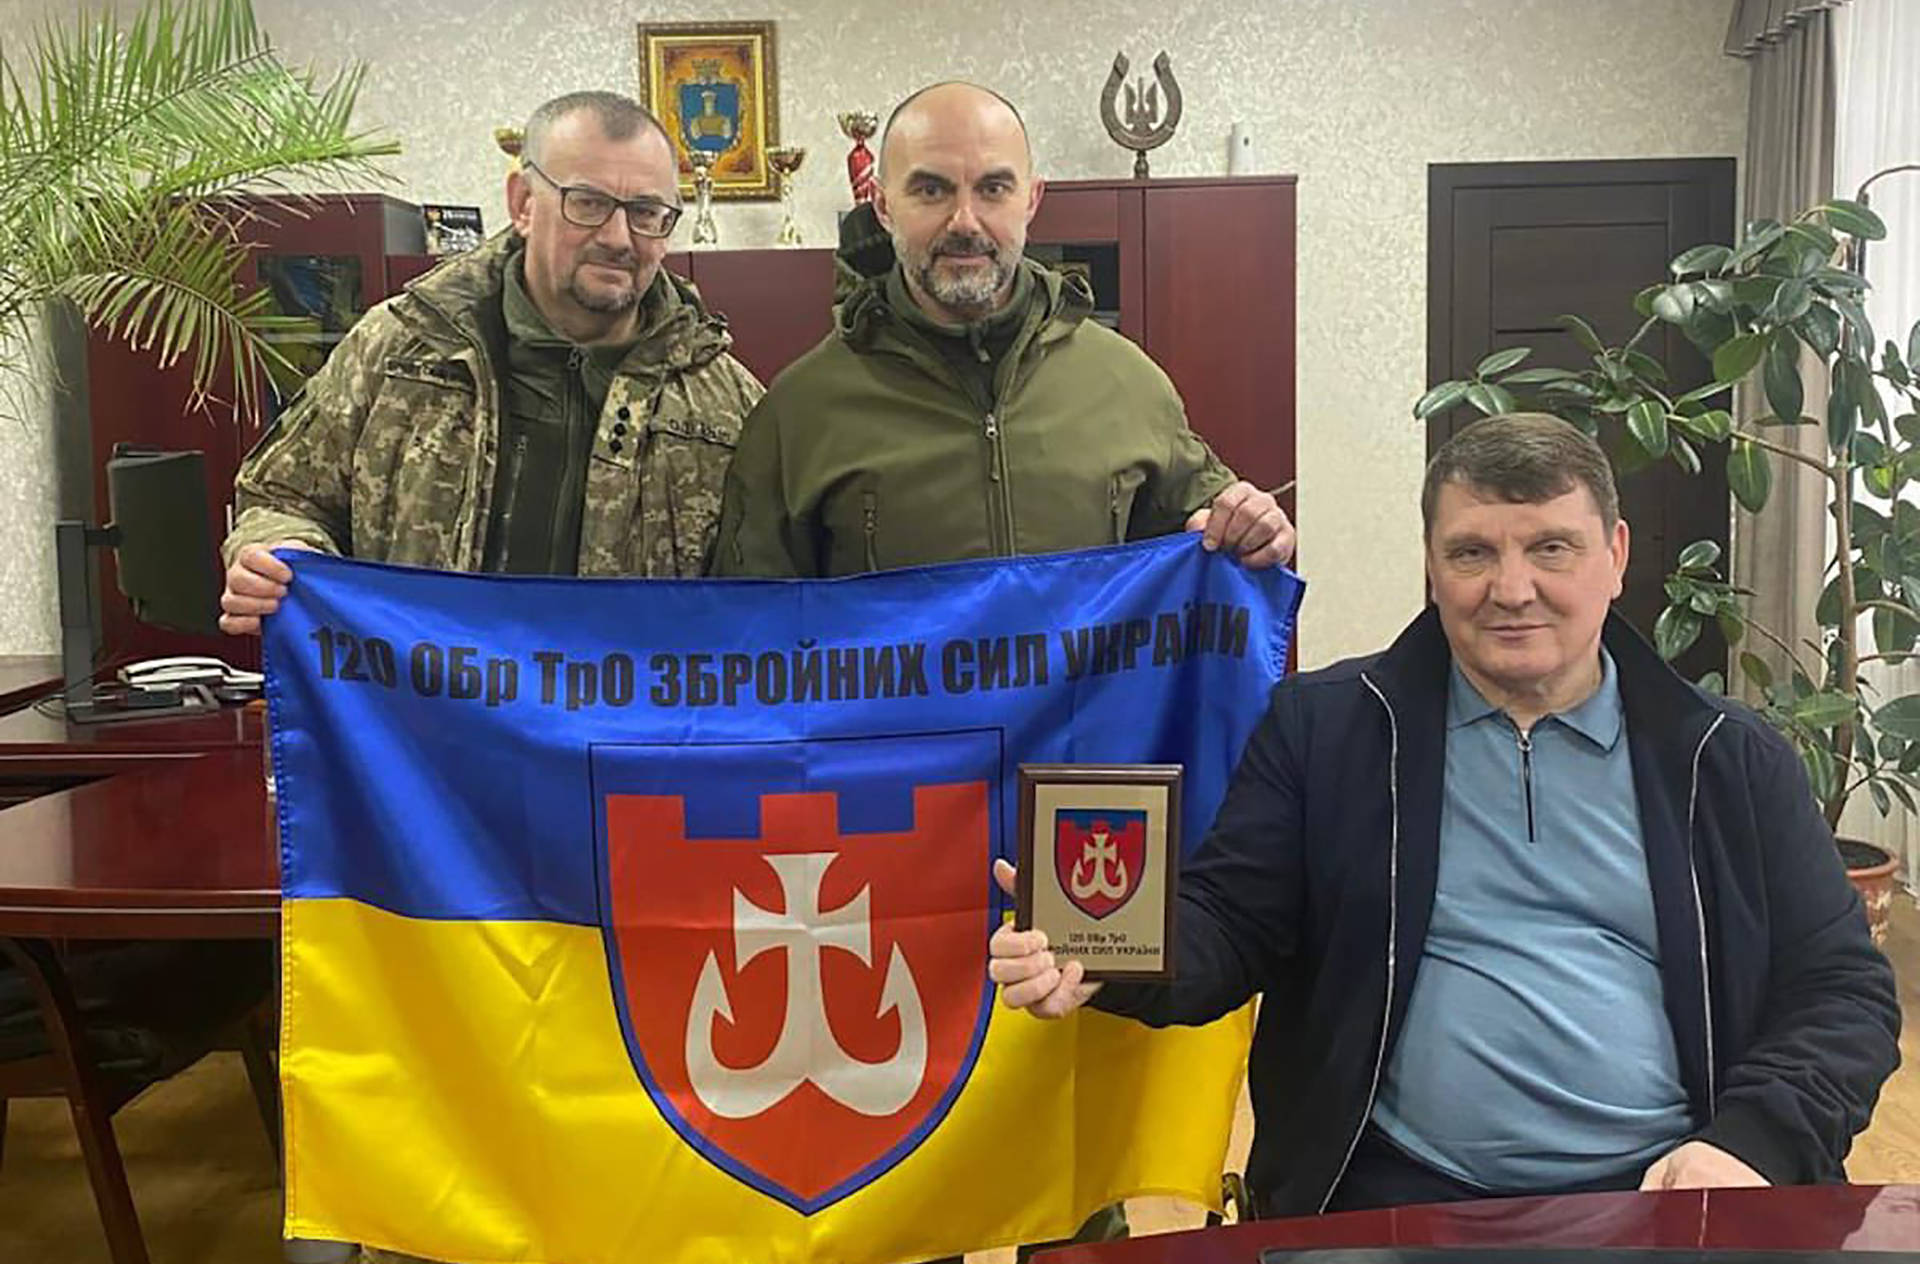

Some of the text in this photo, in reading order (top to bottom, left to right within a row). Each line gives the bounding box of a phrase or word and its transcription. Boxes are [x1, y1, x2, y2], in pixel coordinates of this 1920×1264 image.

[309, 597, 1251, 712] 120 ОБр ТрО ЗБРОЙНИХ СИЛ УКРАЇНИ
